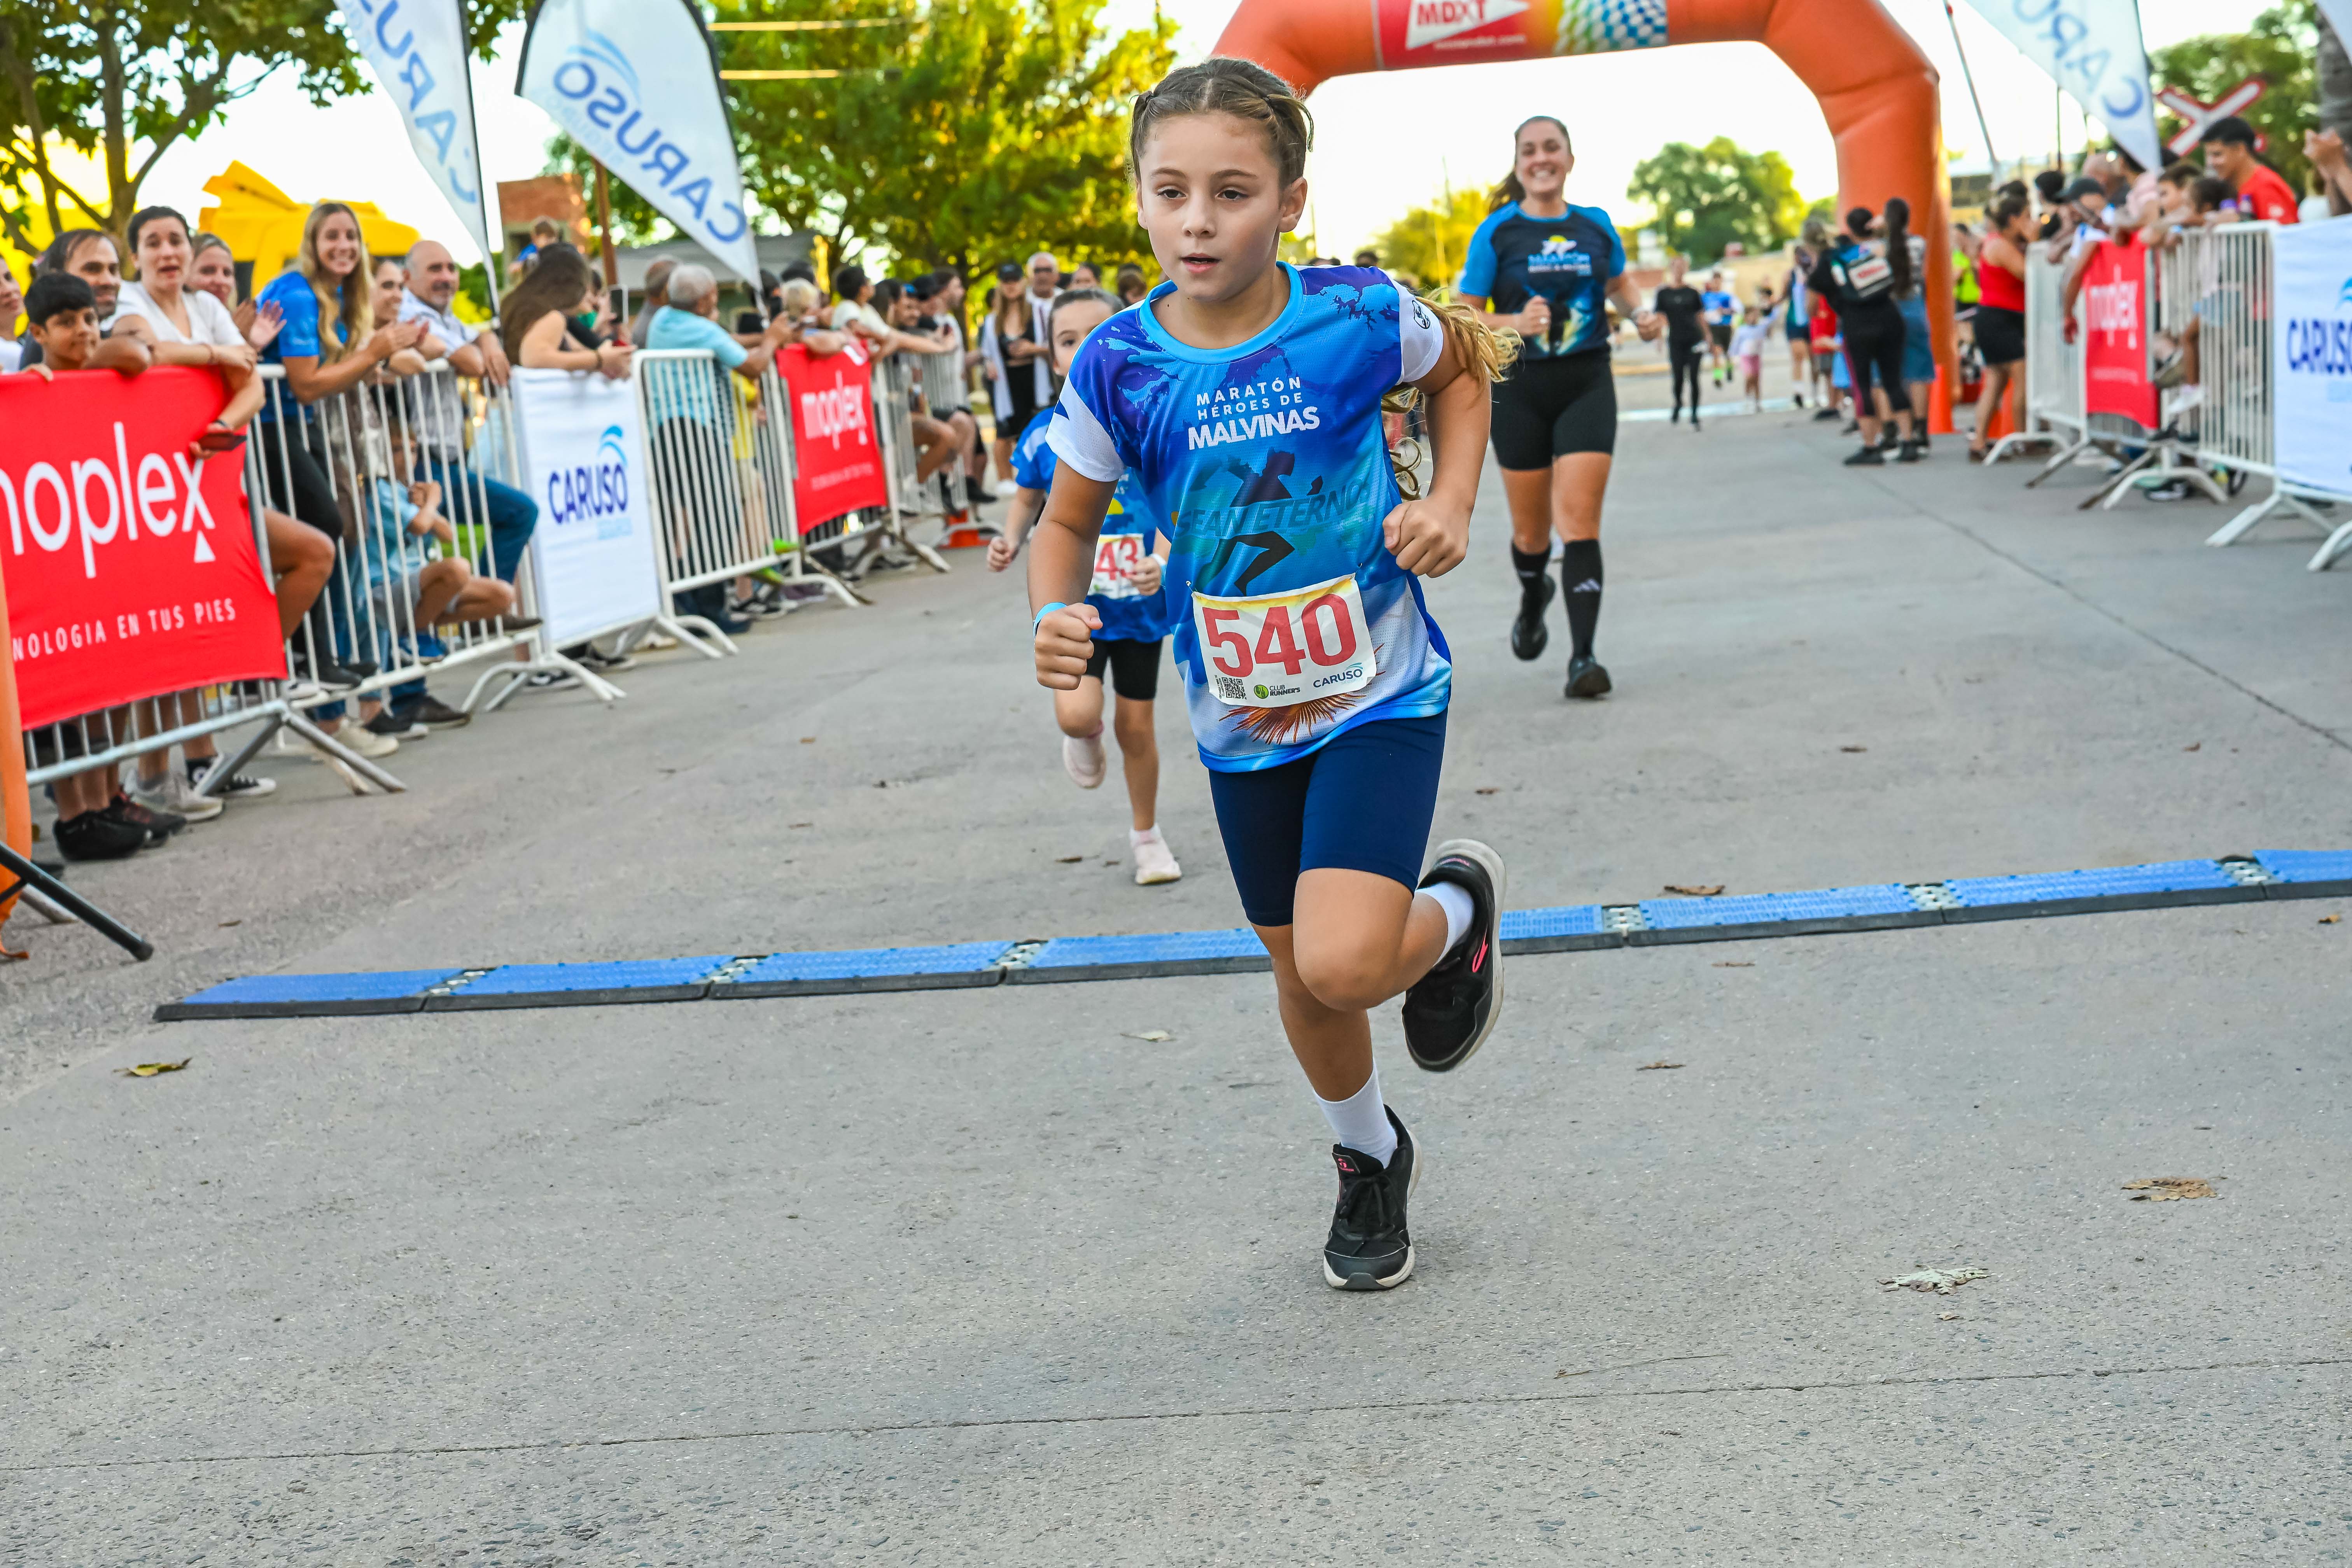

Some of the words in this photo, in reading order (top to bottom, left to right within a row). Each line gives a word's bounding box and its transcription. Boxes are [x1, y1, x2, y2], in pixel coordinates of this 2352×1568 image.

[2286, 318, 2352, 376] CARUS
[1196, 376, 1301, 406] MARATÓN
[1198, 398, 1270, 420] HÉROES
[1280, 392, 1302, 406] DE
[1188, 406, 1320, 450] MALVINAS
[548, 462, 628, 524] CARUSO
[1176, 507, 1248, 537] SEAN
[117, 613, 140, 639] EN
[148, 605, 184, 632] TUS
[194, 597, 236, 624] PIES
[1202, 593, 1356, 677] 540
[1270, 687, 1301, 696] RUNNER'S
[1313, 668, 1363, 688] CARUSO
